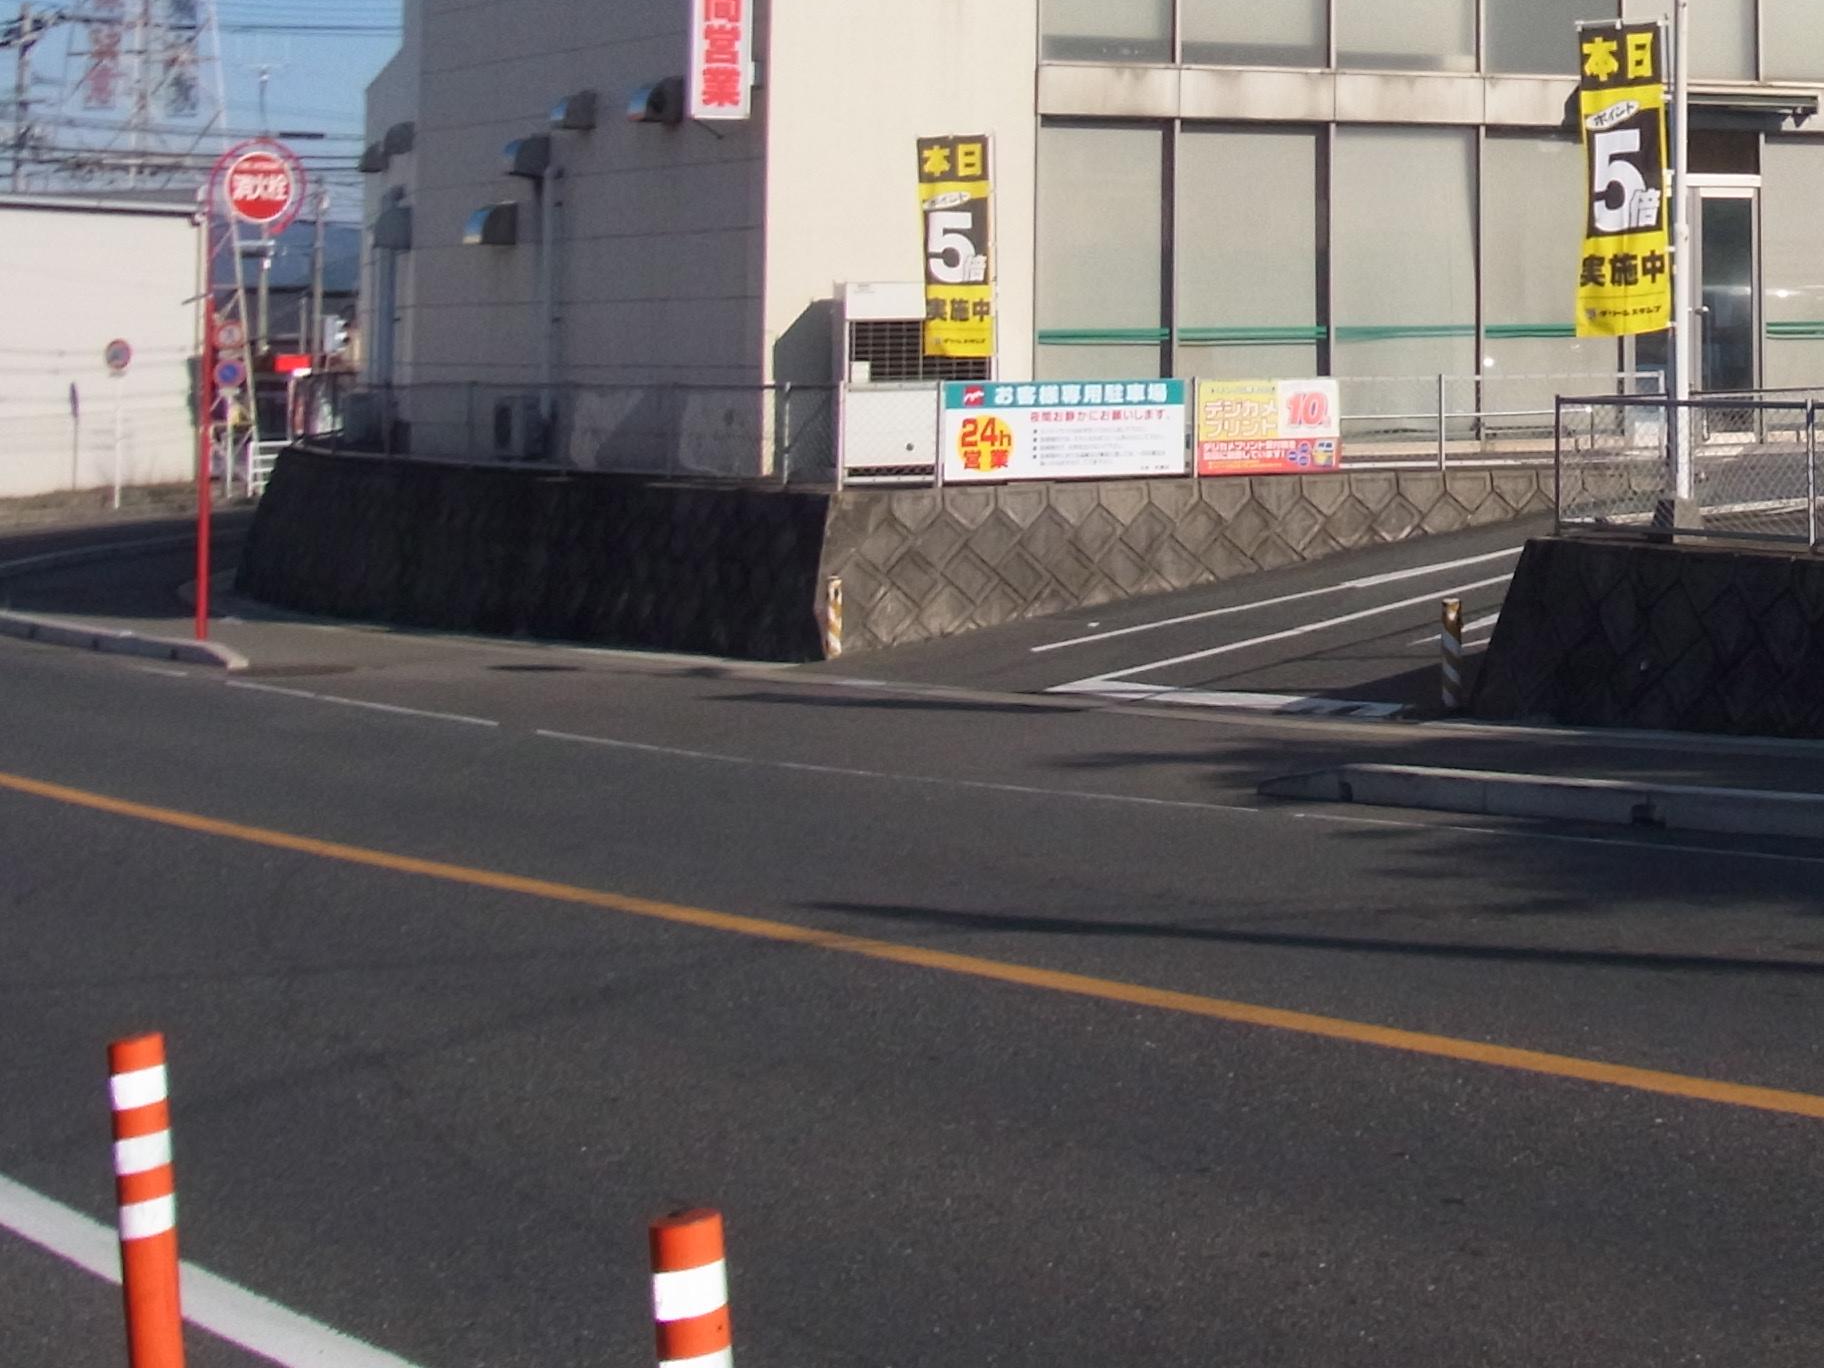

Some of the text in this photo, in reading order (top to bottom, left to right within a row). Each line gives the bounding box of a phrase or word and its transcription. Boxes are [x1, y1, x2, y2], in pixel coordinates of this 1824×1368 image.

[1582, 32, 1653, 81] 本日
[1592, 102, 1636, 126] ポイント
[922, 143, 982, 177] 本日
[232, 173, 289, 201] 消火栓
[1593, 128, 1661, 232] 5倍
[928, 210, 987, 282] 5倍
[1579, 250, 1665, 287] 実施中
[926, 298, 990, 322] 実施中
[994, 383, 1168, 405] お客様専用駐車場
[1030, 409, 1170, 423] 夜間お静かにお願いします。
[1205, 399, 1277, 418] デジカメ
[961, 417, 1012, 448] 24h
[1206, 419, 1277, 437] プリント
[964, 449, 1009, 469] 営業
